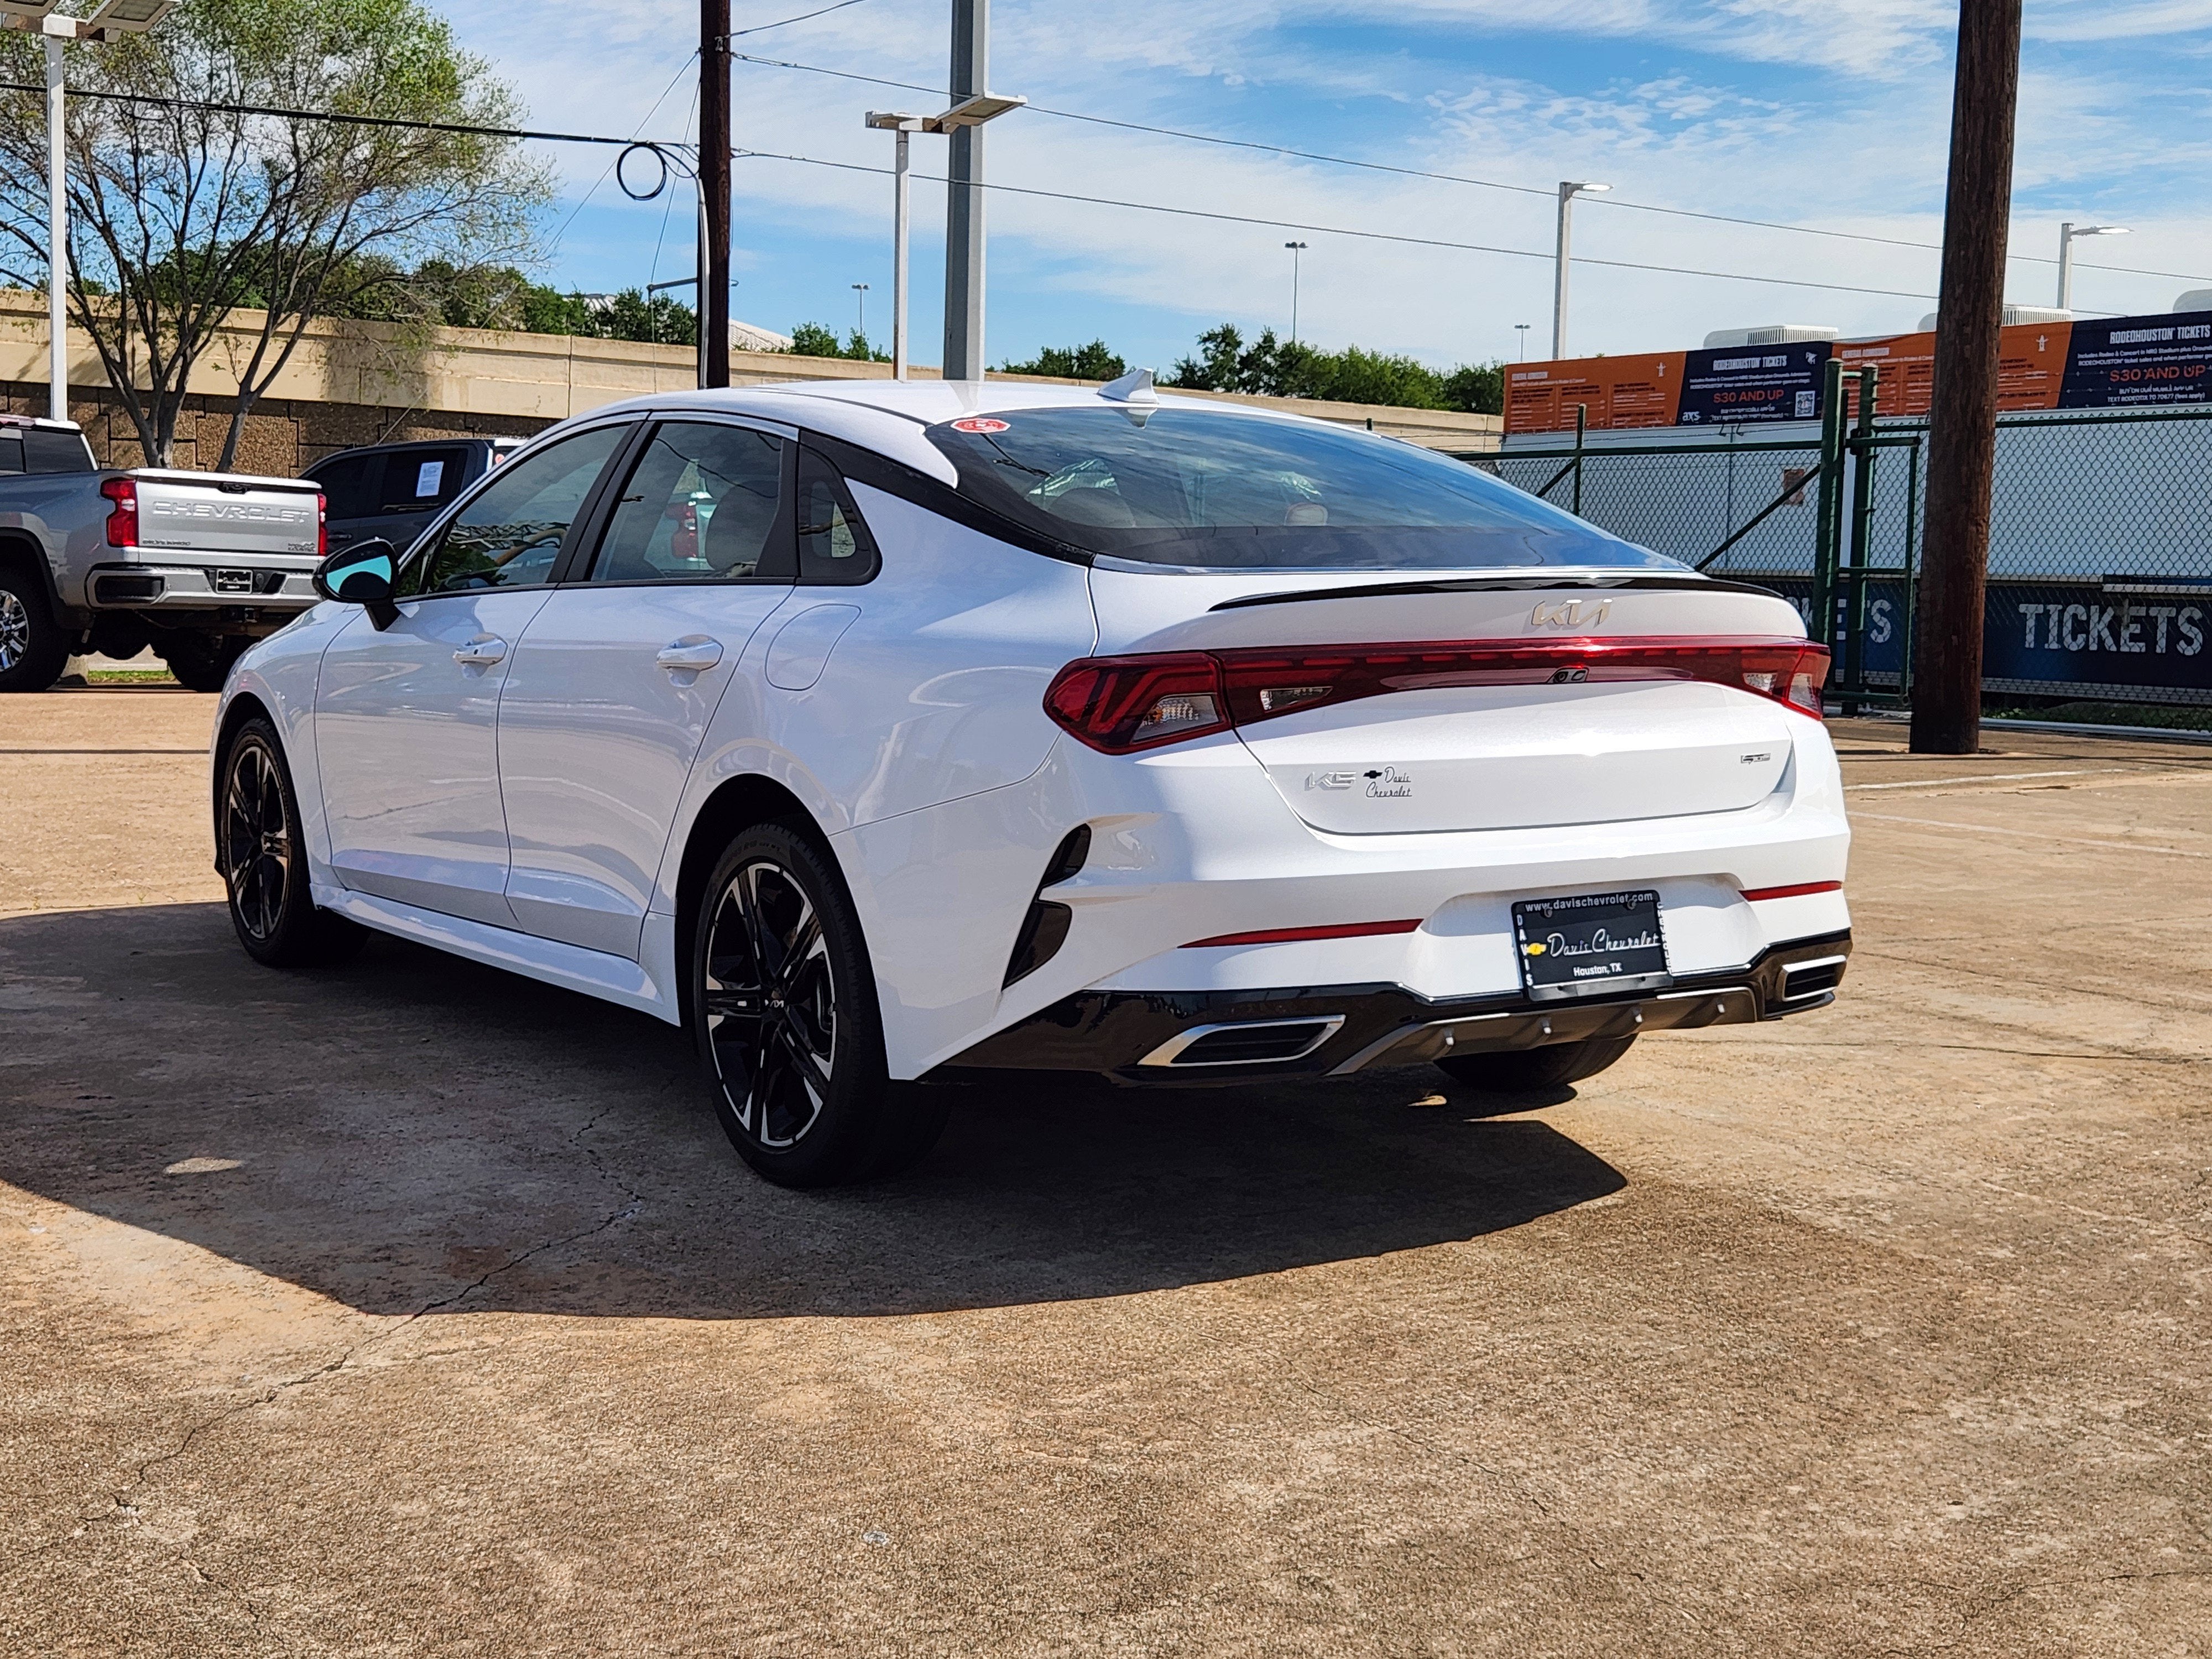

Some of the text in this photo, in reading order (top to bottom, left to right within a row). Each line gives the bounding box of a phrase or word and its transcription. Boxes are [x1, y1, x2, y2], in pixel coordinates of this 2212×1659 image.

[2178, 325, 2210, 340] TICKETS
[2145, 366, 2179, 380] AND
[2183, 364, 2205, 377] UP
[1739, 390, 1765, 402] AND
[1767, 389, 1784, 400] UP
[153, 501, 310, 523] CHEVROLET
[2018, 603, 2203, 656] TICKETS
[1305, 771, 1356, 791] K5
[1384, 766, 1411, 783] Davis
[1366, 781, 1412, 797] Chevrolet
[1525, 893, 1653, 912] www.davischevrolet.com
[1547, 928, 1661, 957] Davis Chevrolet
[1573, 962, 1623, 977] Houston, TX
